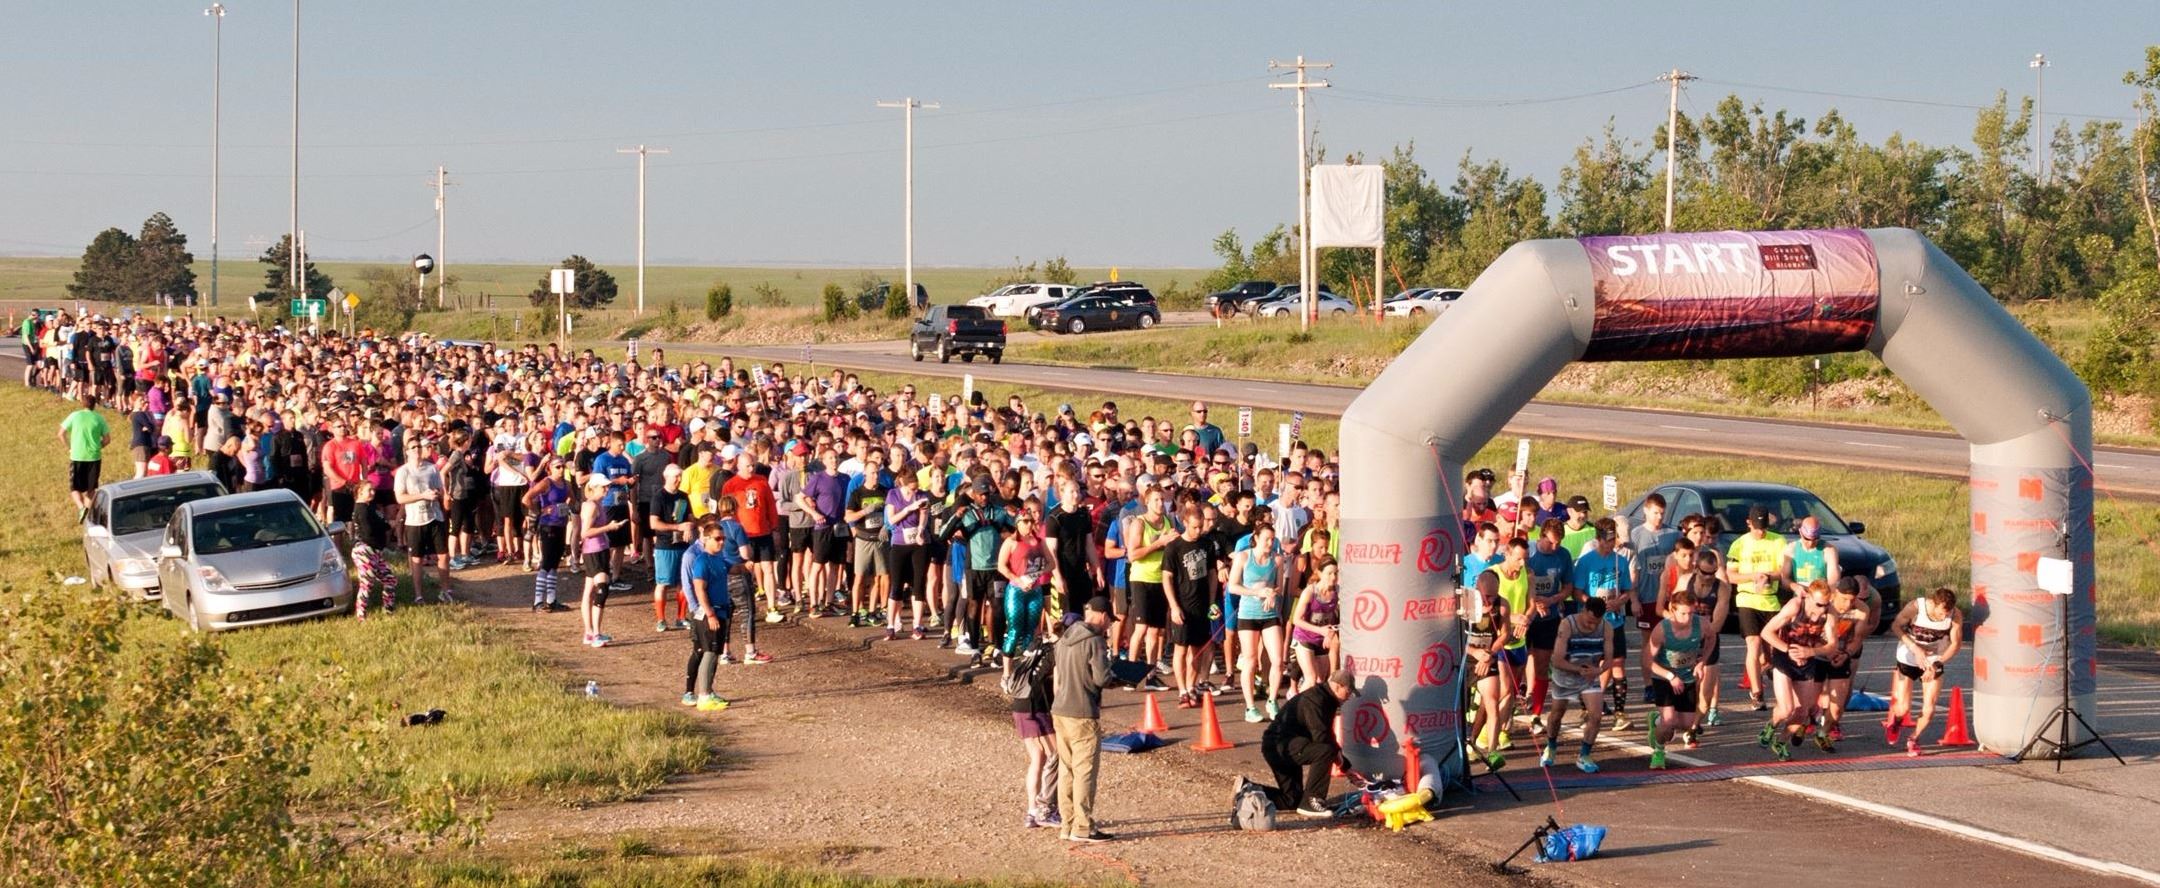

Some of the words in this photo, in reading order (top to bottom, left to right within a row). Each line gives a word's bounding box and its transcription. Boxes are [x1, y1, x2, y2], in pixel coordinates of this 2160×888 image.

[1607, 242, 1749, 277] START
[1241, 413, 1250, 432] 1:40
[1344, 543, 1368, 563] Red
[1369, 543, 1402, 564] Dirt
[1403, 597, 1437, 621] Red
[1369, 657, 1403, 678] Dirt
[1403, 711, 1438, 735] Red
